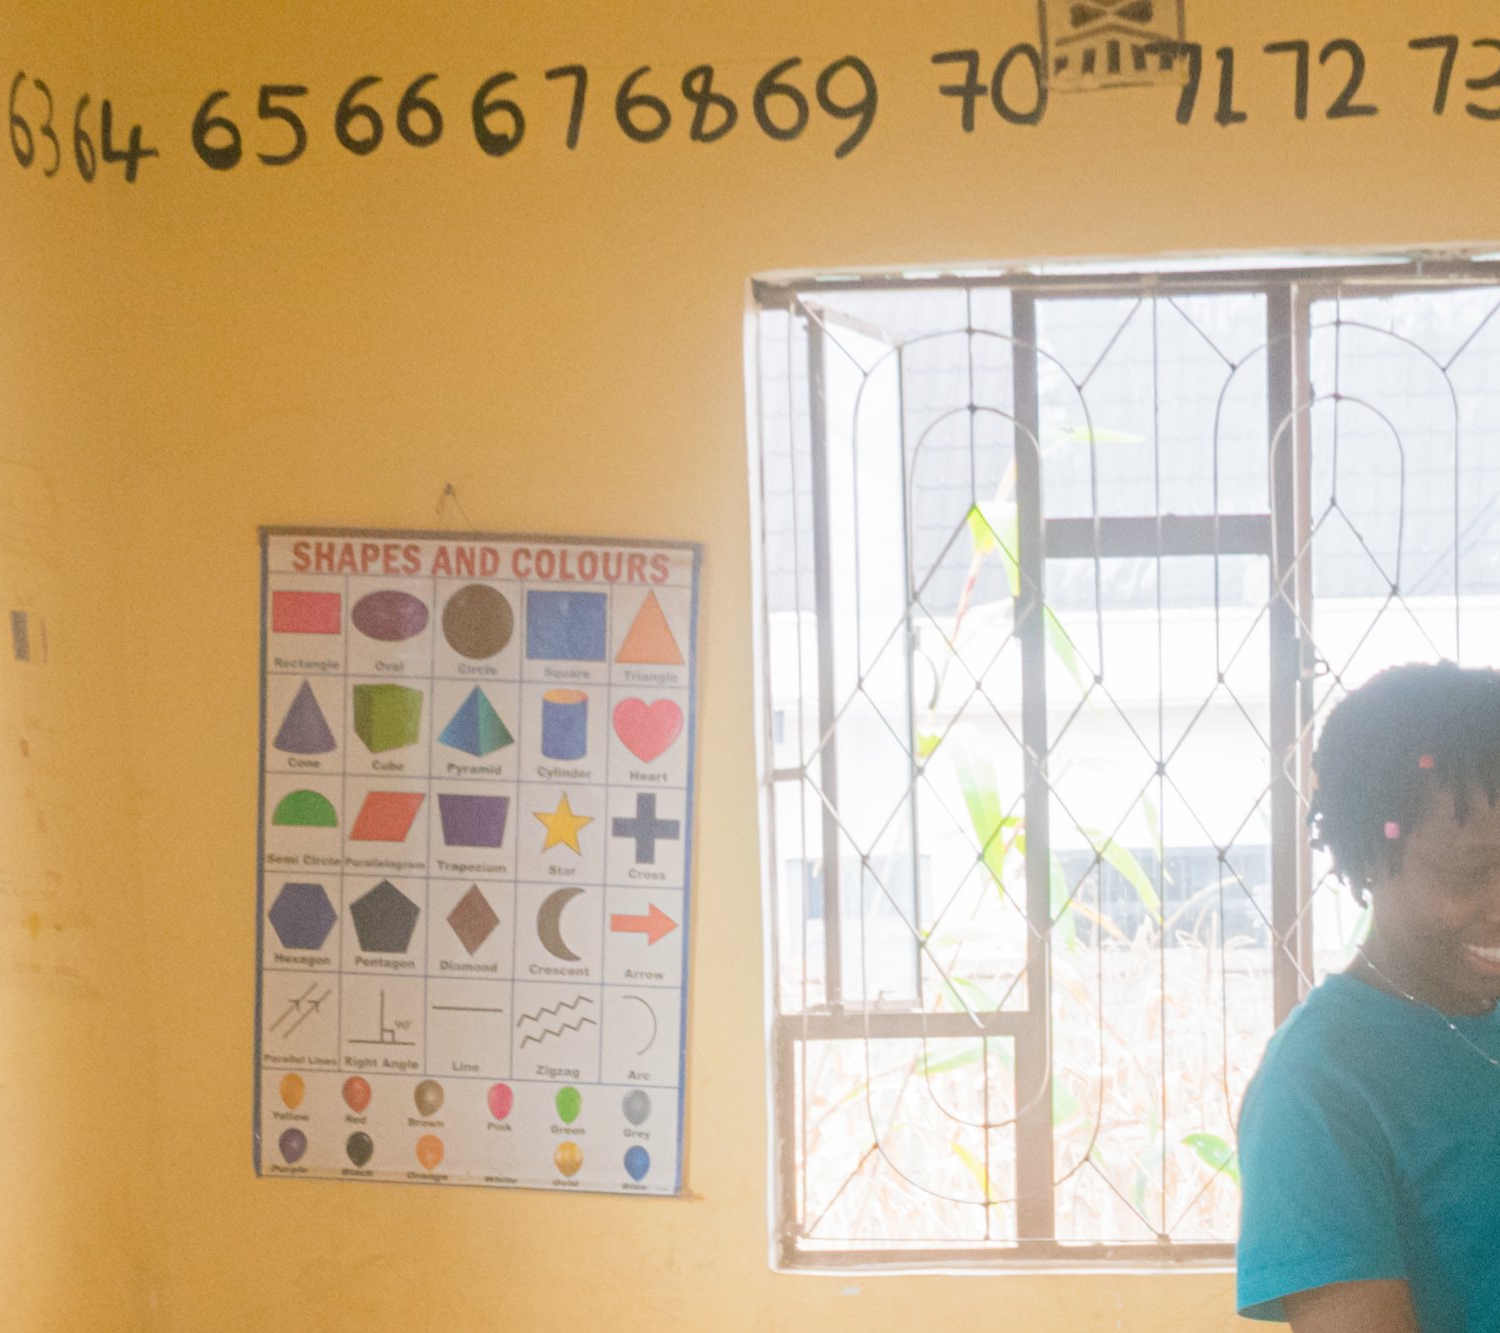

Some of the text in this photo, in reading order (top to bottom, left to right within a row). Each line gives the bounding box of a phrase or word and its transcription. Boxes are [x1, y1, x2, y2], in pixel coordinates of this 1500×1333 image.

[191, 84, 308, 171] 65
[334, 73, 443, 156] 66
[471, 64, 588, 157] 67
[615, 65, 738, 143] 68
[753, 56, 878, 158] 69
[932, 44, 1048, 132] 70
[1145, 42, 1247, 126] 71
[1264, 38, 1378, 120] 72
[8, 70, 61, 178] 63
[73, 93, 160, 185] 64
[291, 540, 671, 585] SHAPES AND COLOURS
[273, 656, 340, 672] Rectangle
[457, 664, 498, 676] Circle
[623, 670, 679, 684] Triangle
[446, 763, 502, 777] Pyramid
[536, 767, 592, 781] Cylinder
[629, 770, 668, 783] Heart
[548, 864, 576, 877] Star
[628, 868, 667, 882] Cross
[439, 960, 498, 974] Diamond
[529, 964, 590, 978] Crescent
[624, 968, 665, 981] Arrow
[344, 1056, 419, 1073] Right Angle
[452, 1061, 480, 1074] Line
[535, 1065, 580, 1080] Zigzag
[627, 1069, 651, 1082] Arc
